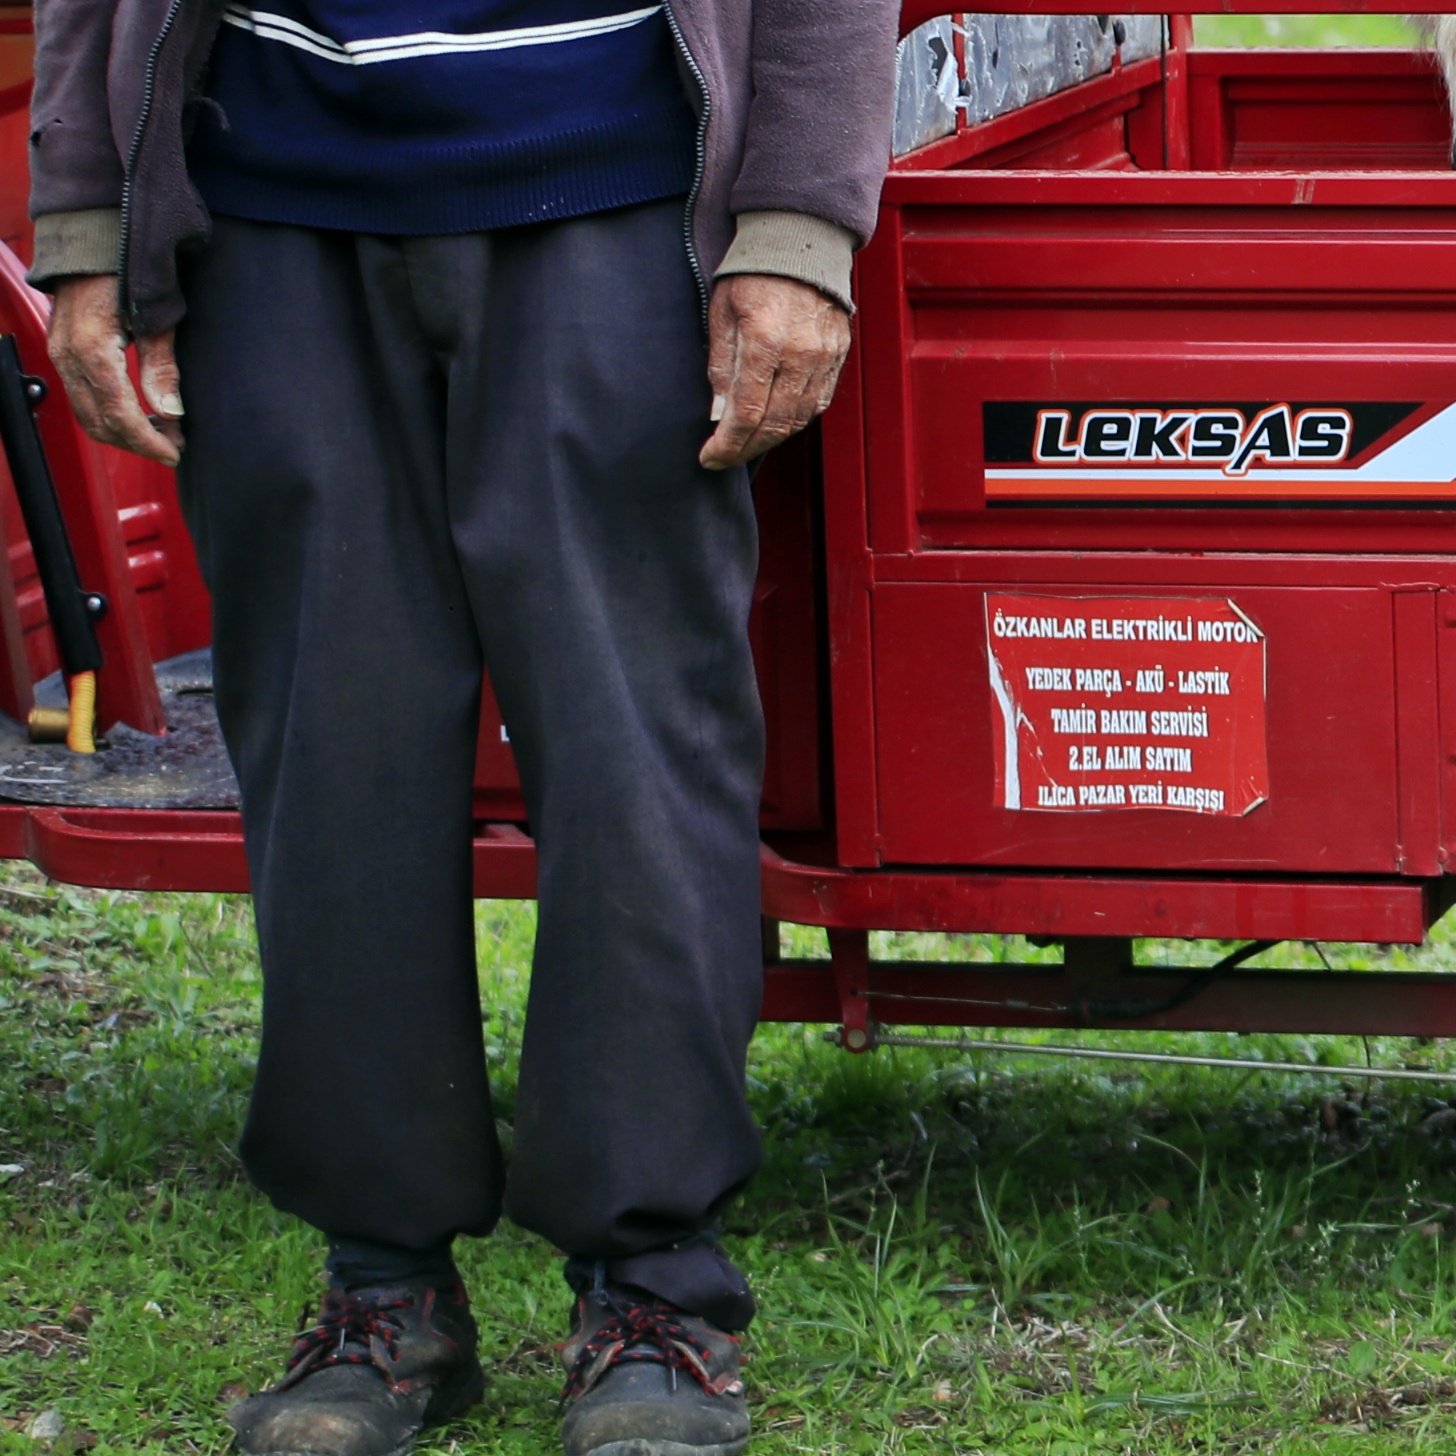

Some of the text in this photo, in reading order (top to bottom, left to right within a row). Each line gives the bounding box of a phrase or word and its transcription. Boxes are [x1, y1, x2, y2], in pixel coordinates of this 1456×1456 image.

[993, 611, 1087, 639] ÖZKANLAR
[1091, 615, 1193, 642] ELEKTRİKLİ
[1025, 667, 1072, 690] YEDEK
[1075, 668, 1122, 698] PARÇA
[1136, 664, 1165, 693] AKÜ
[1178, 666, 1230, 695] LASTİK
[1050, 702, 1208, 737] TAMİR BAKIM SERVİSİ
[1069, 745, 1192, 772] 2.EL ALIM SATIM
[1079, 784, 1126, 805] PAZAR
[1129, 780, 1163, 804] YERİ
